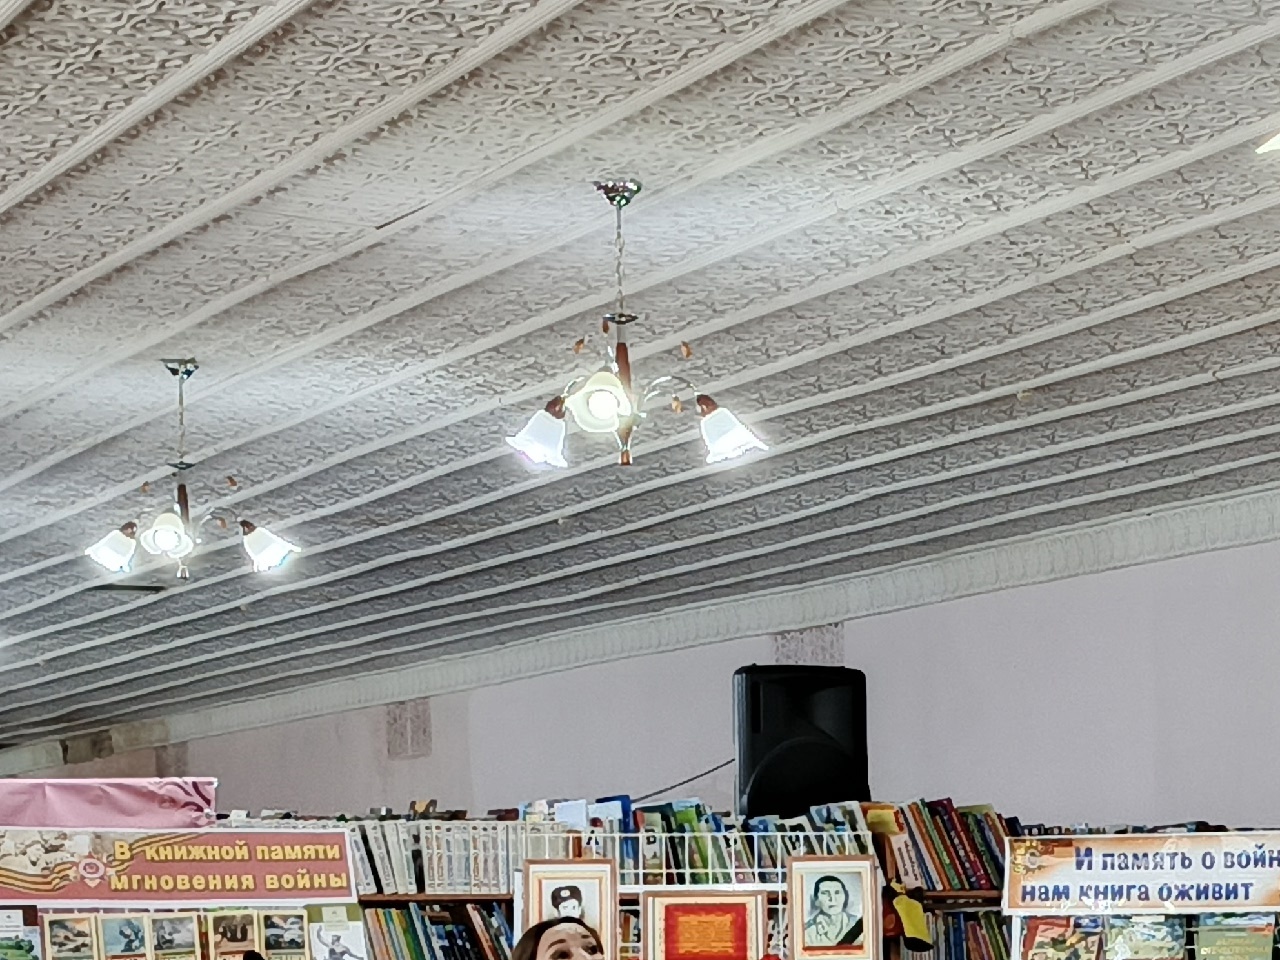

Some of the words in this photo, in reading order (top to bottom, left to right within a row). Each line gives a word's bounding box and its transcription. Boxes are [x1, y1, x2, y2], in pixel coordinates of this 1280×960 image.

[113, 840, 132, 861] В
[144, 840, 249, 861] книжной
[256, 843, 341, 861] памяти
[1074, 846, 1094, 871] И
[1101, 852, 1193, 872] память
[1201, 851, 1216, 871] о
[110, 872, 255, 892] мгновения
[265, 868, 348, 890] войны
[1021, 883, 1071, 904] нам
[1078, 882, 1150, 904] книга
[1157, 882, 1255, 904] оживит
